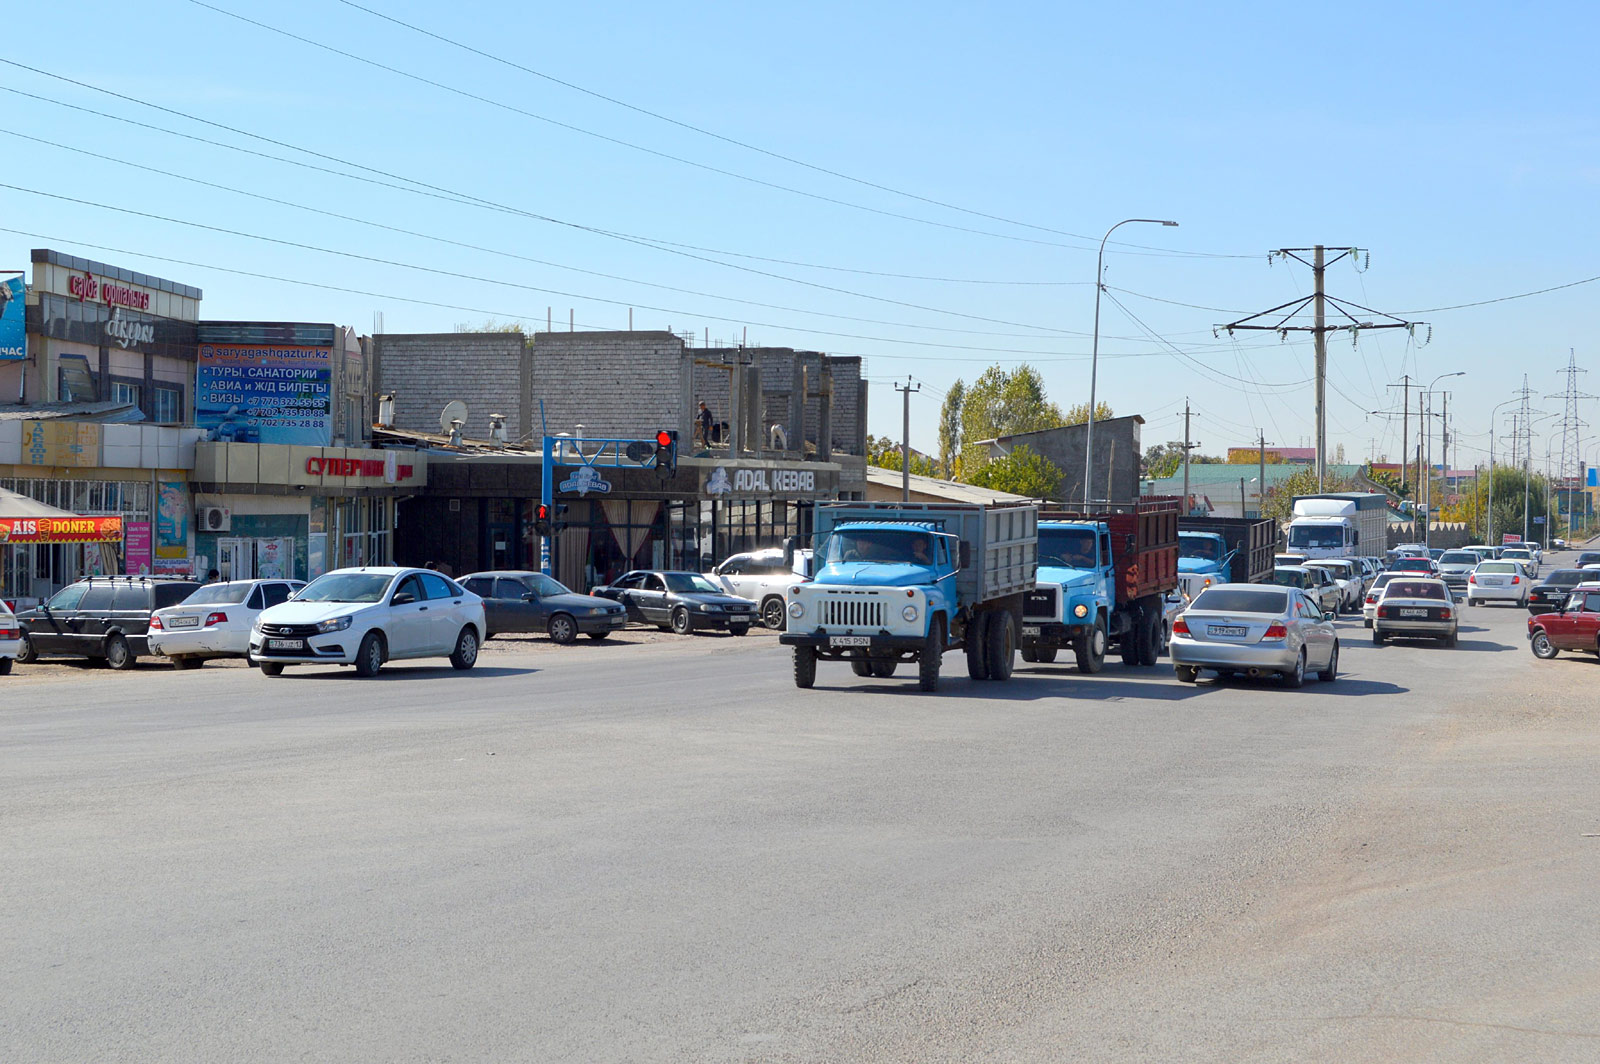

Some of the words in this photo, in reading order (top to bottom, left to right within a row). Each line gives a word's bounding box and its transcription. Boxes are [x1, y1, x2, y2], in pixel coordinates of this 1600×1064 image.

[70, 272, 99, 302] сауда
[216, 346, 328, 359] saryagashqaztur.kz
[210, 367, 245, 378] ТУРЫ,
[248, 368, 317, 378] САНАТОРИИ
[210, 381, 242, 390] АВИА
[245, 383, 251, 391] и
[255, 382, 276, 392] Ж/Д
[279, 382, 327, 392] БИЛЕТЫ
[210, 394, 244, 403] ВИЗЫ
[247, 397, 259, 405] +7
[261, 398, 278, 406] 776
[281, 398, 297, 406] 322
[300, 399, 311, 407] 55
[313, 399, 325, 407] 55
[247, 408, 259, 416] +7
[261, 408, 278, 417] 702
[281, 409, 297, 417] 735
[300, 409, 311, 417] 38
[313, 410, 325, 418] 88
[247, 419, 259, 427] +7
[261, 419, 278, 427] 702
[281, 420, 297, 428] 735
[300, 420, 311, 428] 28
[313, 420, 325, 428] 88
[734, 469, 770, 491] ADAL
[772, 470, 815, 492] KEBAB
[12, 520, 37, 535] AIS
[52, 520, 96, 534] DONER
[832, 637, 838, 645] X
[839, 637, 851, 645] 415
[853, 637, 869, 645] PSN
